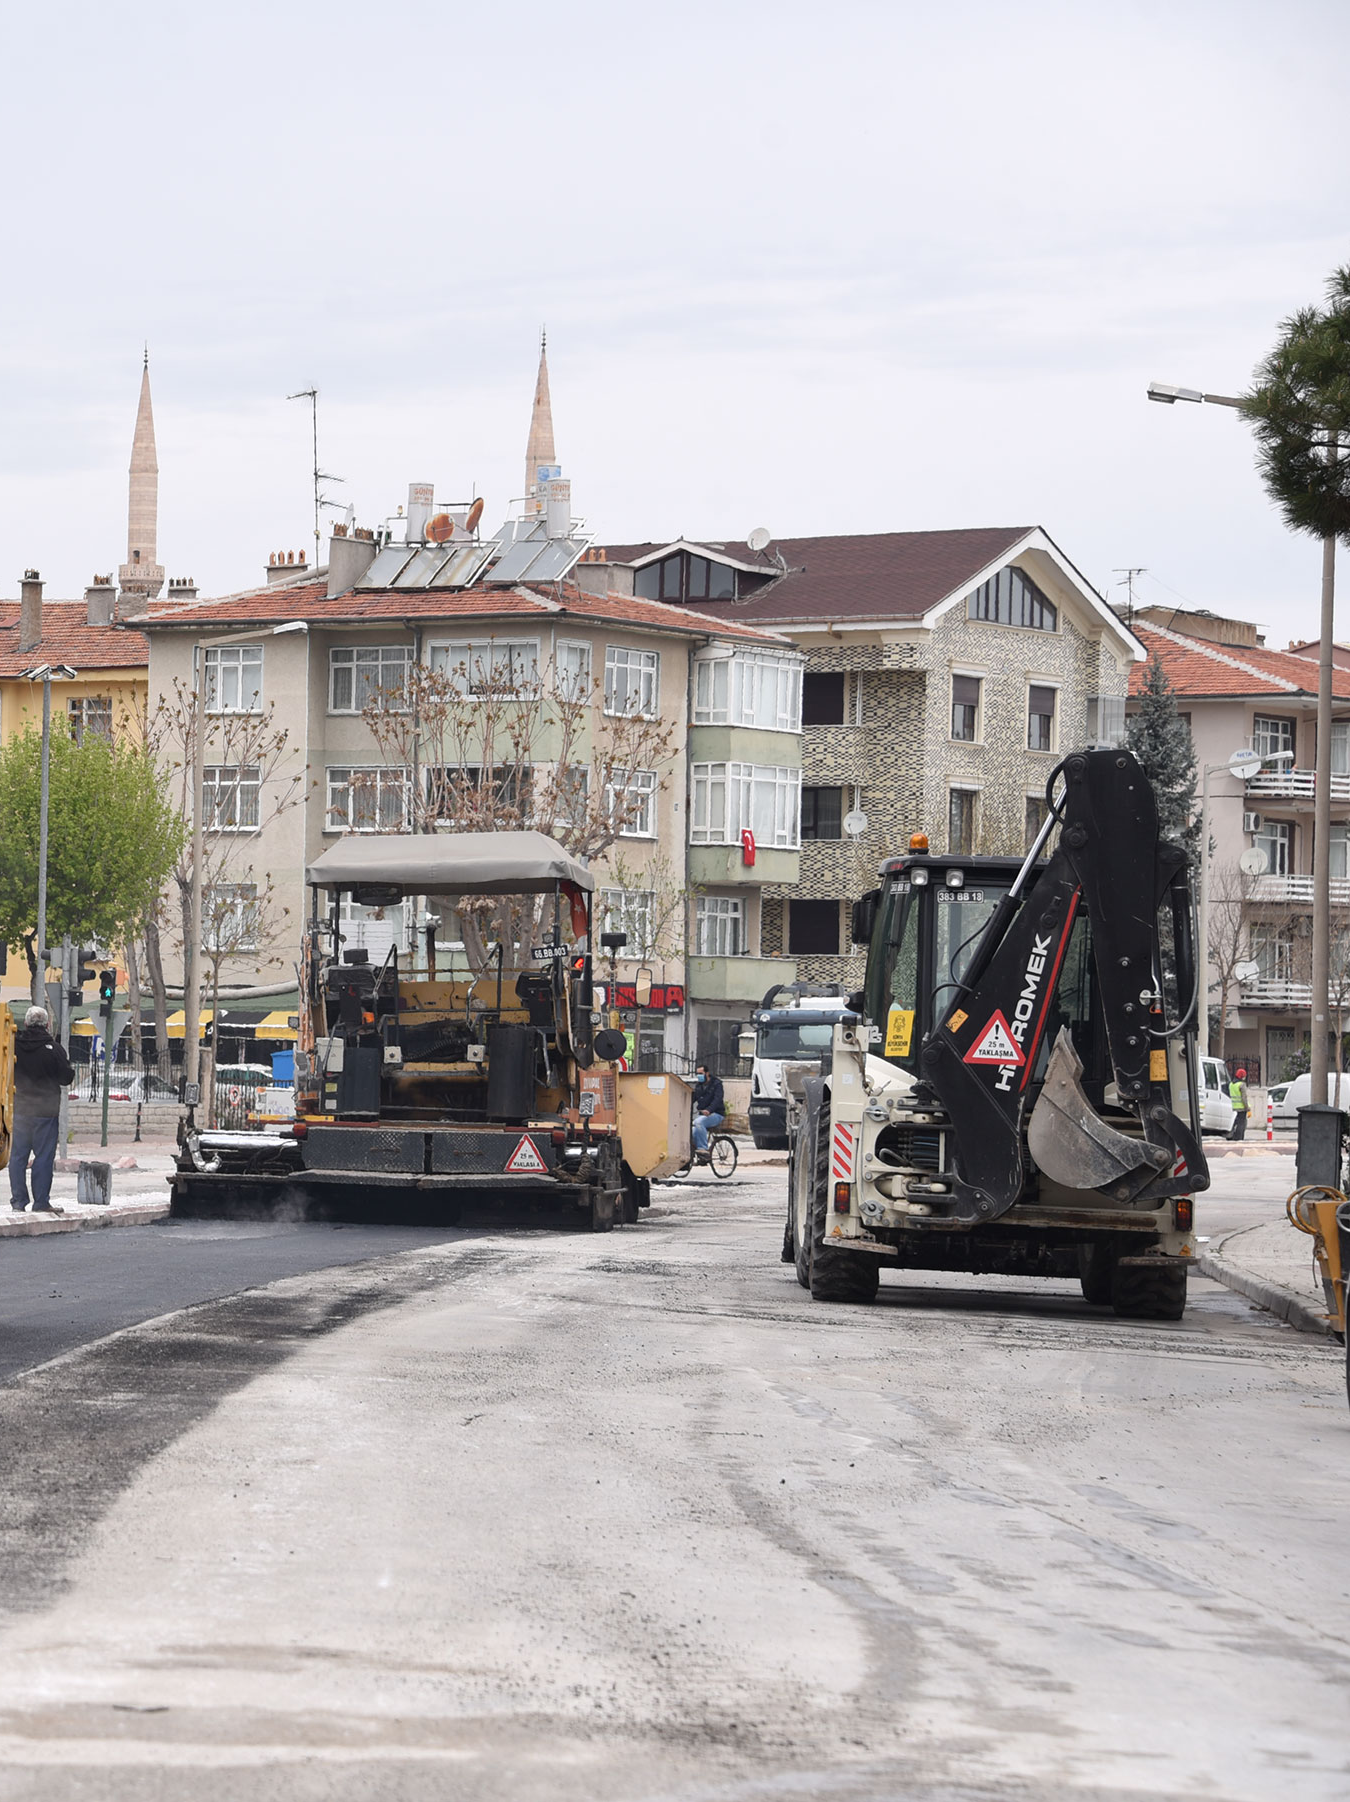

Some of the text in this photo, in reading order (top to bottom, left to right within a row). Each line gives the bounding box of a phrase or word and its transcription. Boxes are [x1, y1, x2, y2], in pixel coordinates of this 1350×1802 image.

[939, 892, 955, 901] 383
[957, 892, 970, 901] BB
[978, 1049, 1014, 1058] YAKLAŞMA
